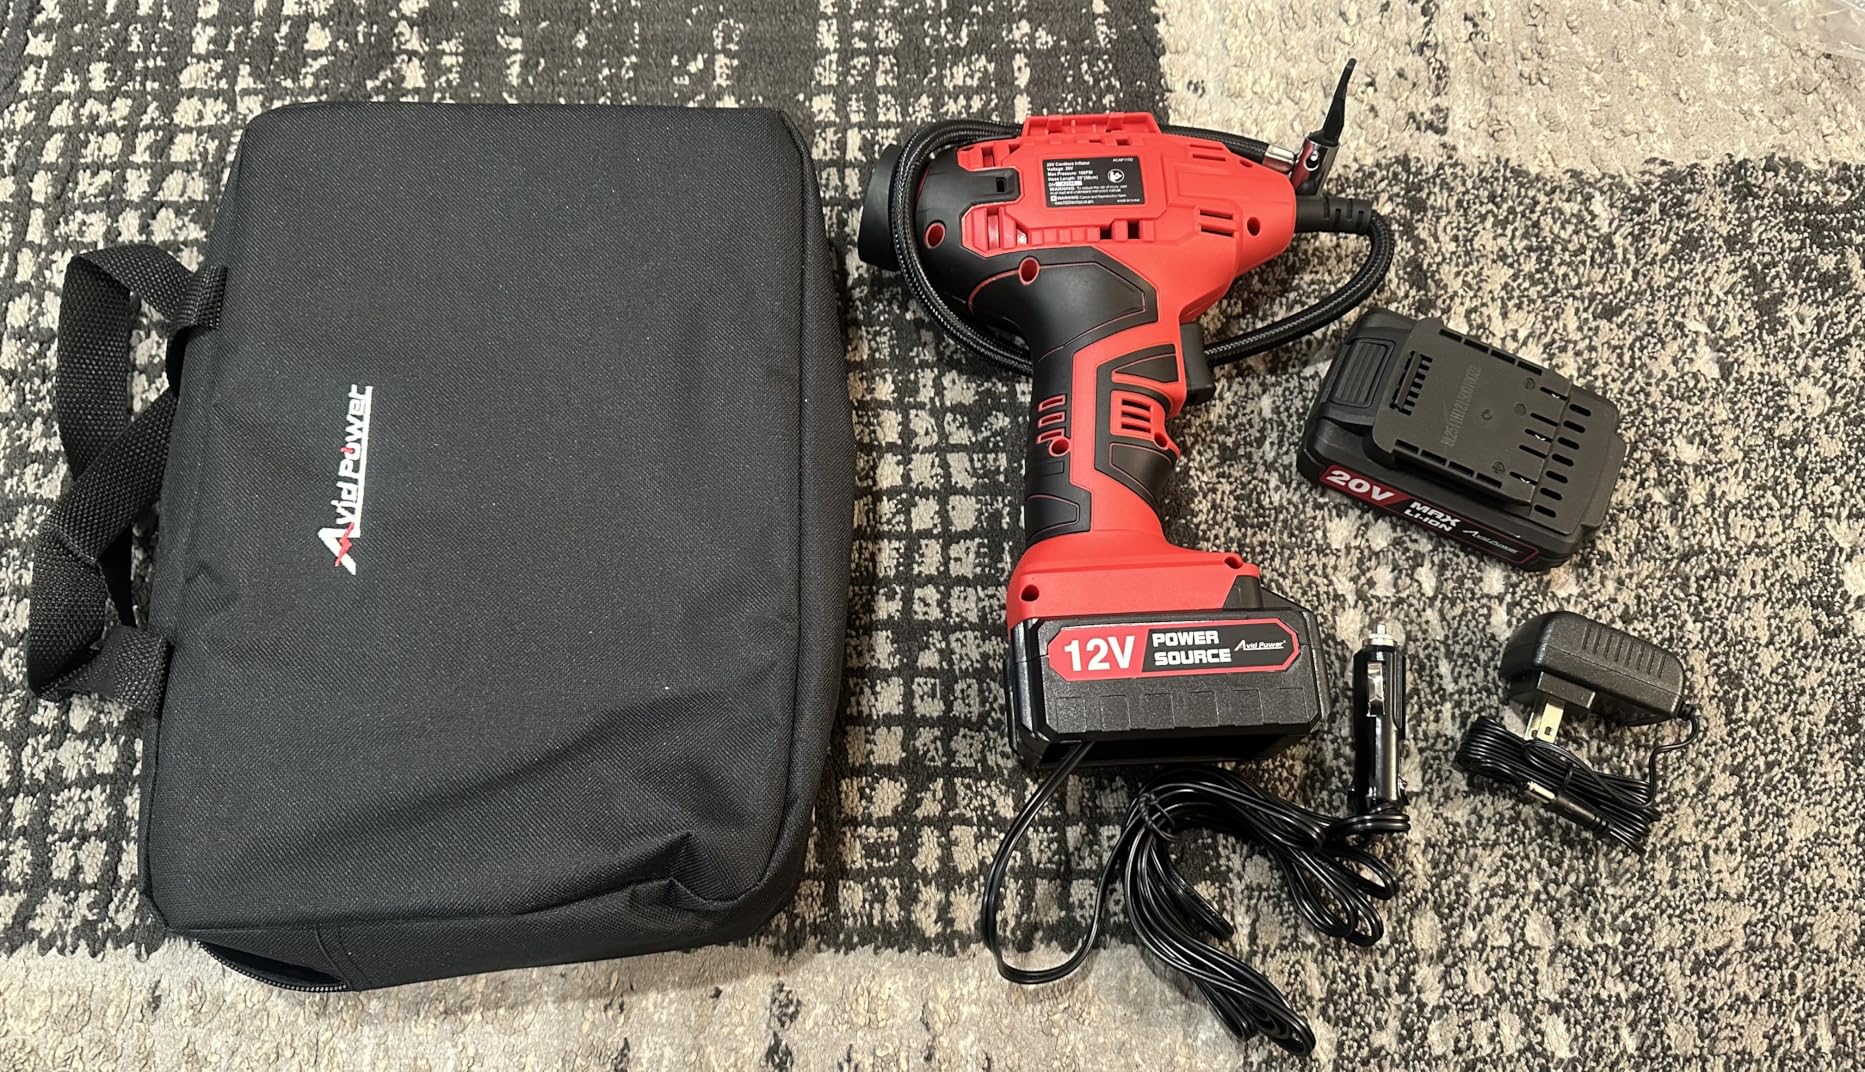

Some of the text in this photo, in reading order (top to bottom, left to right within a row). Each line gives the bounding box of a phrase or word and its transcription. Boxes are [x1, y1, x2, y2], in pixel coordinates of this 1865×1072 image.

[317, 384, 372, 576] Avid Power
[1326, 470, 1394, 501] 20V
[1403, 508, 1452, 533] LI-ION
[1408, 501, 1462, 527] MAX
[1151, 630, 1220, 647] POWER
[1234, 639, 1258, 651] Avid
[1064, 635, 1136, 672] 12V
[1153, 648, 1232, 666] SOURCE
